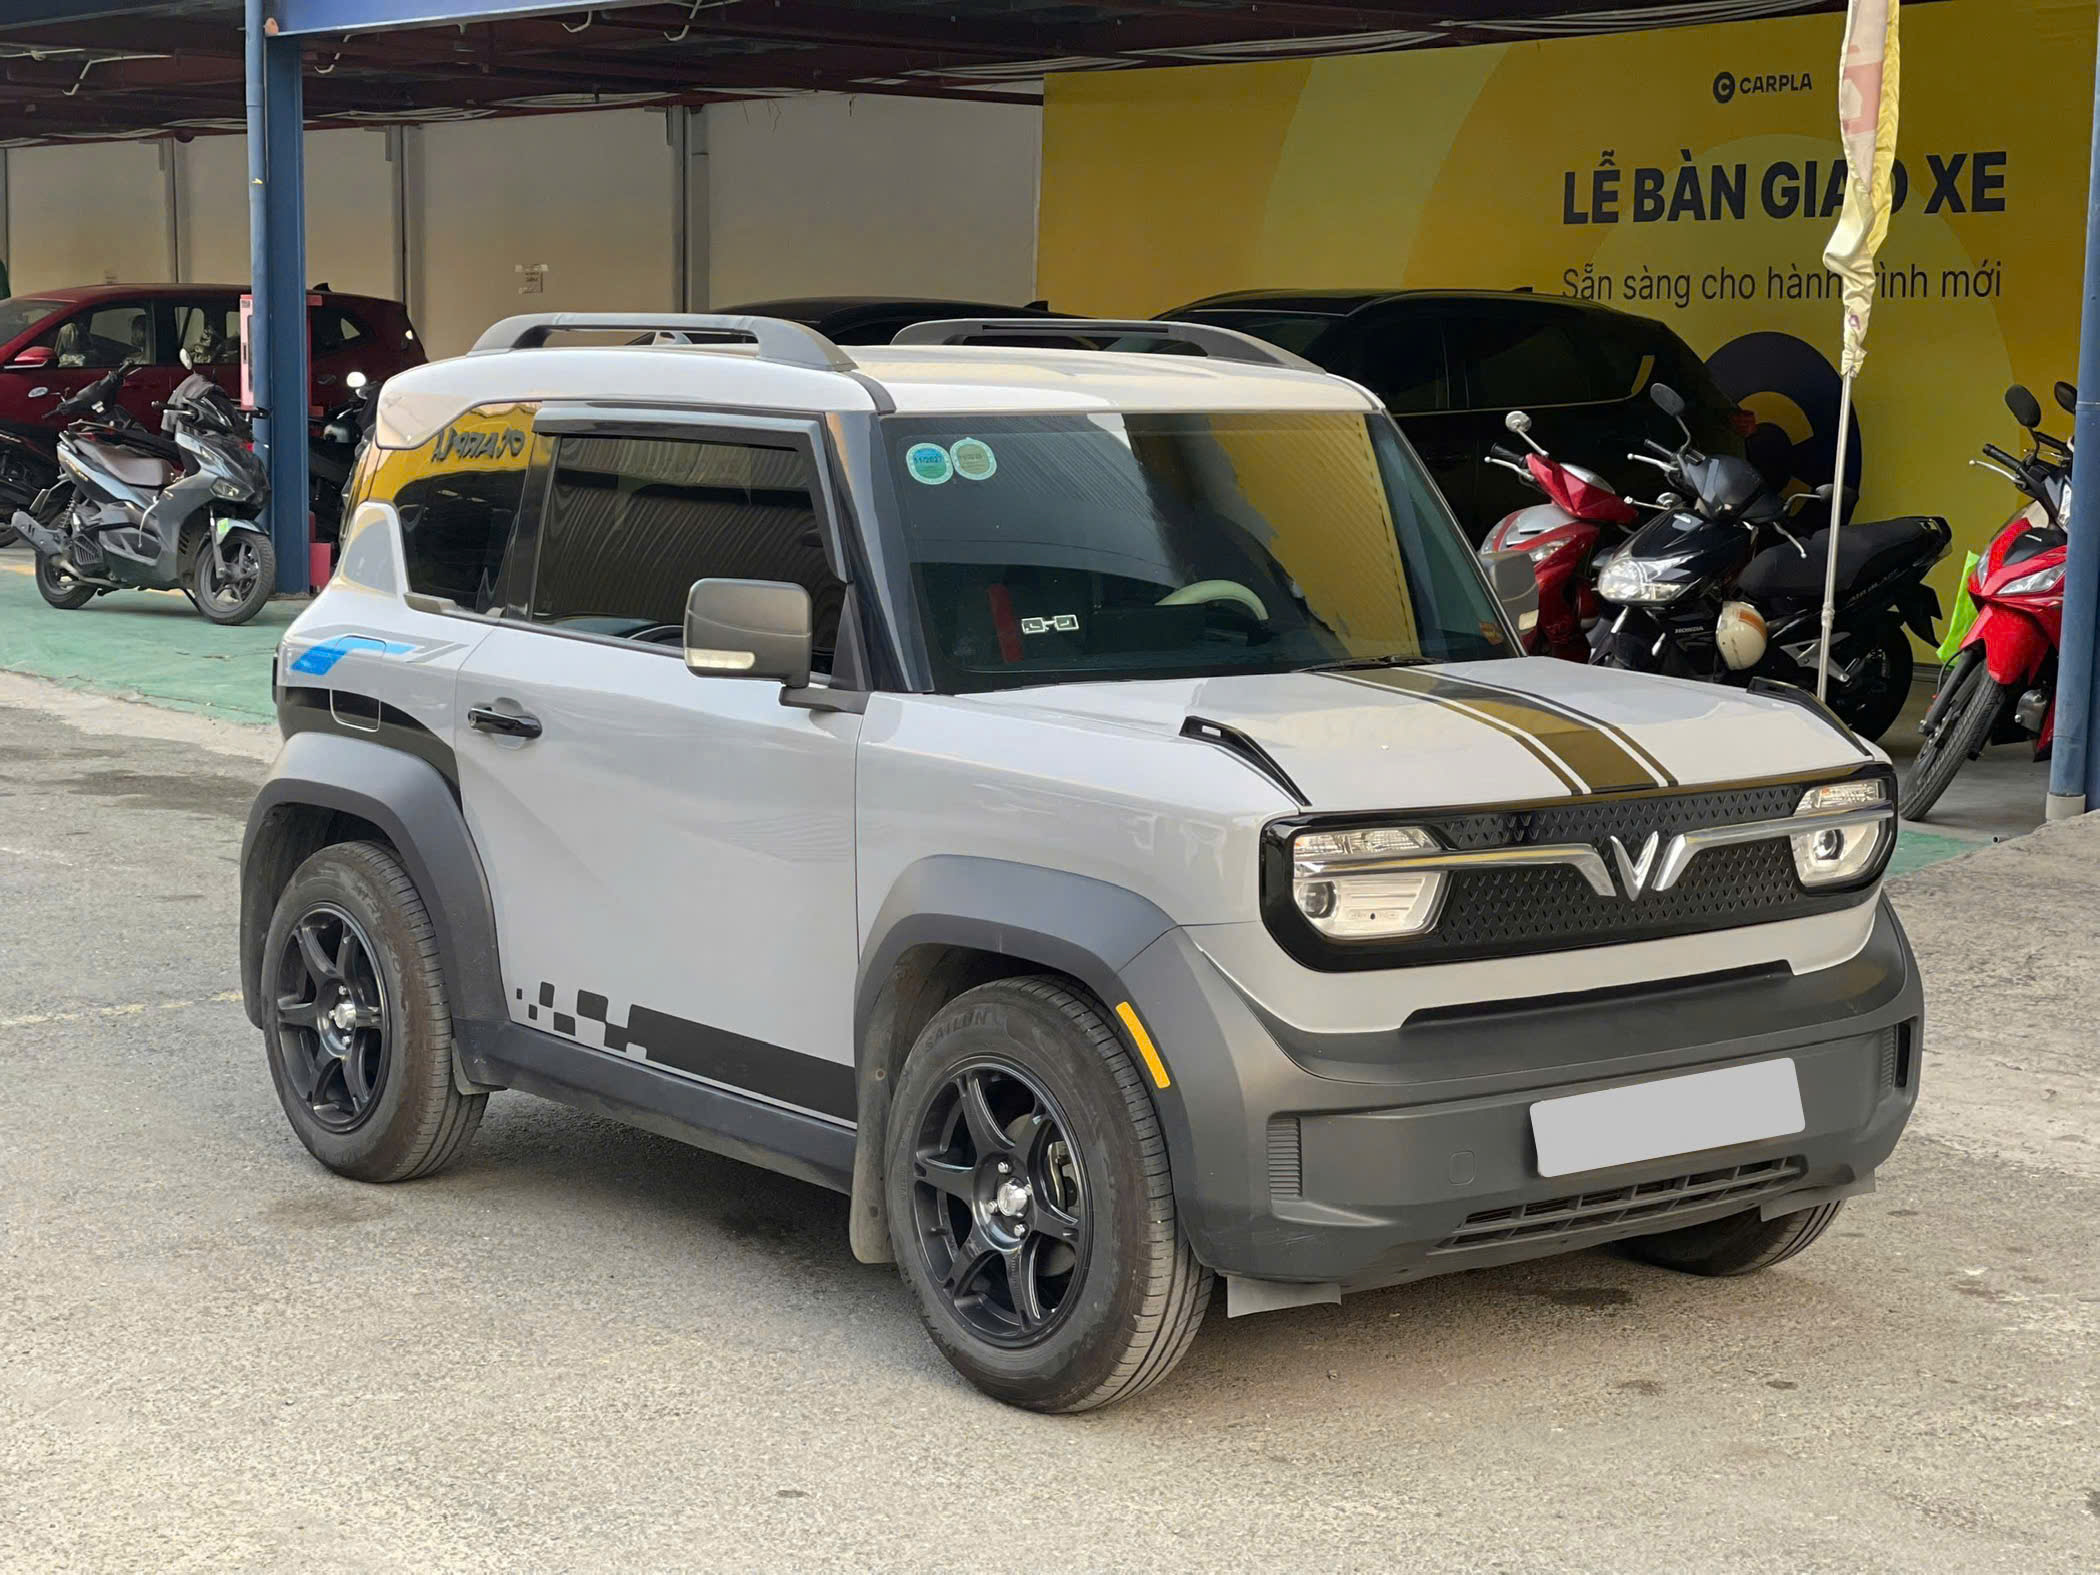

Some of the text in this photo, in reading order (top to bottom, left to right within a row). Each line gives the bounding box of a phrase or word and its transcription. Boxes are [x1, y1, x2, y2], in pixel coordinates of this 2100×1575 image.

[1739, 72, 1813, 95] CARPLA
[1563, 150, 1621, 225] LỄ
[1633, 149, 1747, 223] BÀN
[1924, 151, 2007, 214] XE
[1562, 263, 1612, 300] Sẵn
[1623, 265, 1691, 309] sàng
[1702, 266, 1756, 300] cho
[1941, 259, 2001, 298] mới
